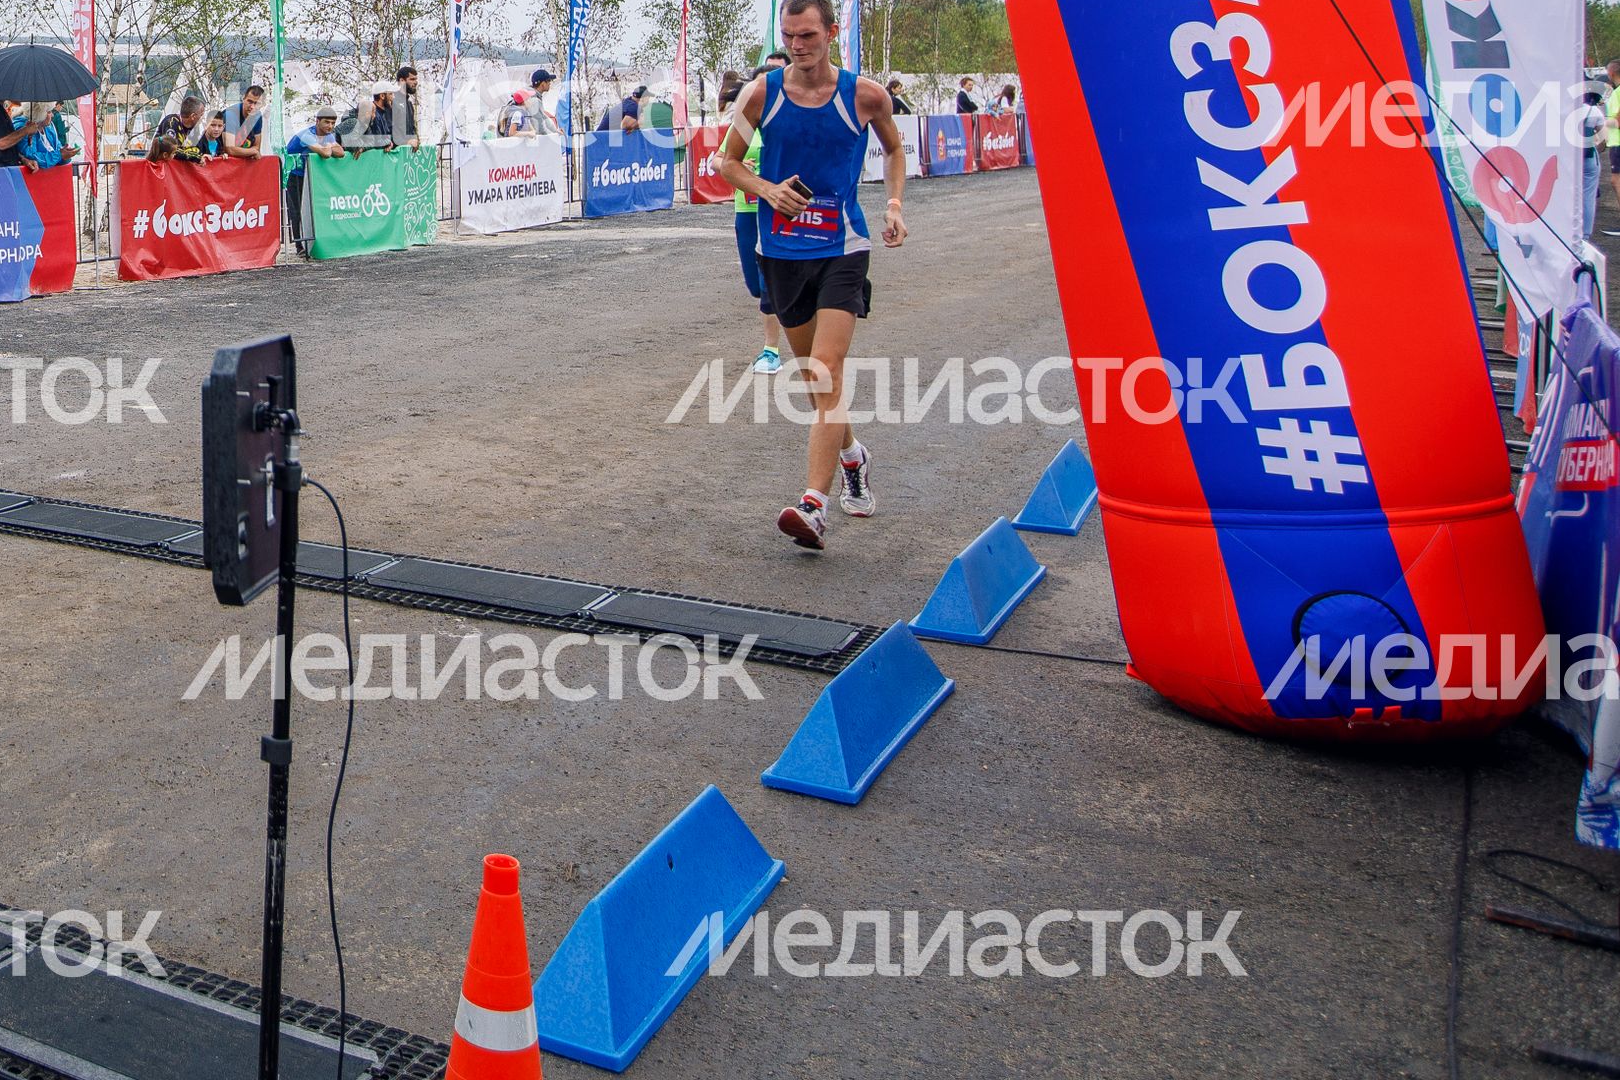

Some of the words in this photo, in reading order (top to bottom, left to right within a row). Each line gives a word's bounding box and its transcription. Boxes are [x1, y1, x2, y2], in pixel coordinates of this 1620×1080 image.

[488, 163, 537, 183] КОМАНДА
[592, 158, 668, 187] #боксЗабег
[468, 187, 503, 206] УМАРА
[506, 180, 557, 201] КРЕМЛЕВА
[132, 197, 269, 239] #боксЗабег
[790, 210, 823, 226] 115
